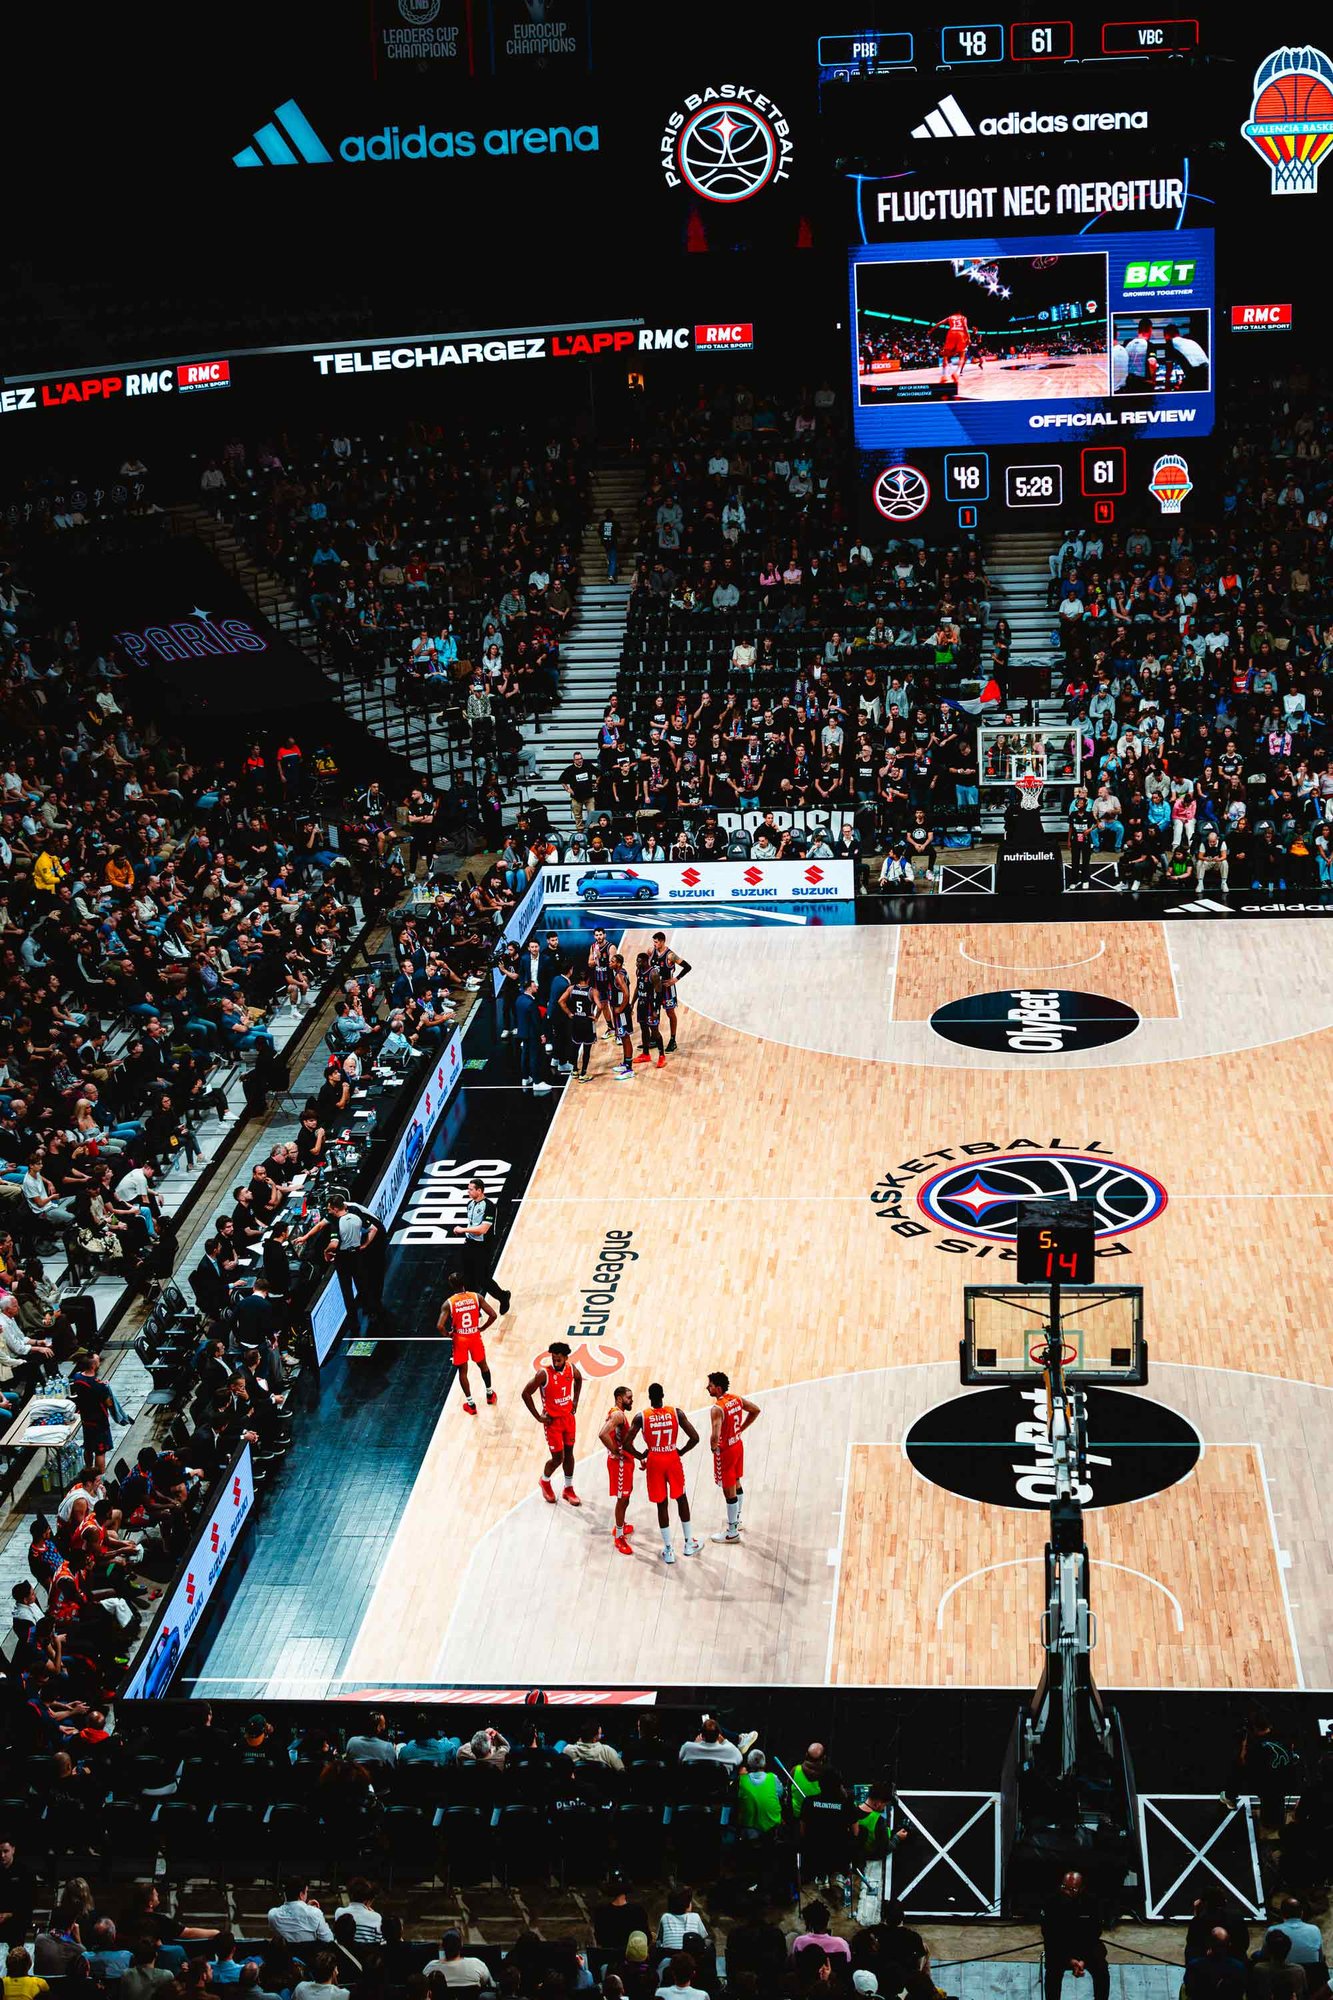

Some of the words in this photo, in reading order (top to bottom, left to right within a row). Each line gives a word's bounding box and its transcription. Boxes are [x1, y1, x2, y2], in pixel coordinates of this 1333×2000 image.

[383, 28, 434, 44] LEADERS
[436, 27, 460, 42] CUP
[514, 23, 567, 39] EUROCUP
[1031, 28, 1053, 53] 61
[1138, 29, 1163, 46] VBC
[387, 42, 457, 59] CHAMPIONS
[506, 38, 577, 55] CHAMPIONS
[959, 31, 987, 56] 48
[979, 112, 1069, 136] adidas
[1072, 111, 1149, 132] arena
[1252, 124, 1299, 134] VALENCIA
[338, 125, 476, 163] adidas
[484, 123, 601, 155] arena
[661, 111, 685, 188] PARIS
[684, 84, 793, 184] BASKETBALL
[877, 187, 997, 223] FLUCTUAT
[1003, 185, 1050, 216] NEC
[1057, 179, 1183, 213] MERGITUR
[1126, 263, 1194, 284] BKT
[1243, 307, 1281, 323] RMC
[706, 327, 743, 342] RMC
[313, 338, 546, 376] TELECHARGEZ
[552, 331, 635, 356] L'APP
[638, 328, 690, 351] RMC
[187, 364, 220, 383] RMC
[0, 388, 37, 413] EZ
[42, 377, 123, 407] L'APP
[126, 370, 173, 397] RMC
[1029, 411, 1118, 429] OFFICIAL
[1121, 409, 1196, 425] REVIEW
[954, 467, 980, 489] 48
[1094, 461, 1114, 483] 61
[1016, 476, 1053, 497] 5:28
[964, 513, 971, 524] 1
[1100, 505, 1109, 518] 4
[114, 606, 270, 668] PARIS
[669, 889, 715, 898] SUZUKI
[731, 888, 777, 897] SUZUKI
[792, 887, 838, 896] SUZUKI
[1241, 904, 1333, 912] adidas
[576, 1001, 583, 1013] 5
[1005, 991, 1077, 1051] OlyBet
[870, 1138, 1114, 1239] BASKETBALL
[389, 1159, 512, 1245] PARIS
[934, 1238, 1134, 1262] PRIS
[1045, 1253, 1078, 1278] 14
[567, 1230, 640, 1337] EuroLeague
[462, 1312, 473, 1328] 8
[561, 1386, 567, 1397] 7
[649, 1413, 672, 1423] SIMA
[651, 1429, 673, 1447] 77
[230, 1496, 248, 1538] SUZUKI
[208, 1541, 227, 1586] SUZUKI
[183, 1591, 205, 1639] SUZUKI
